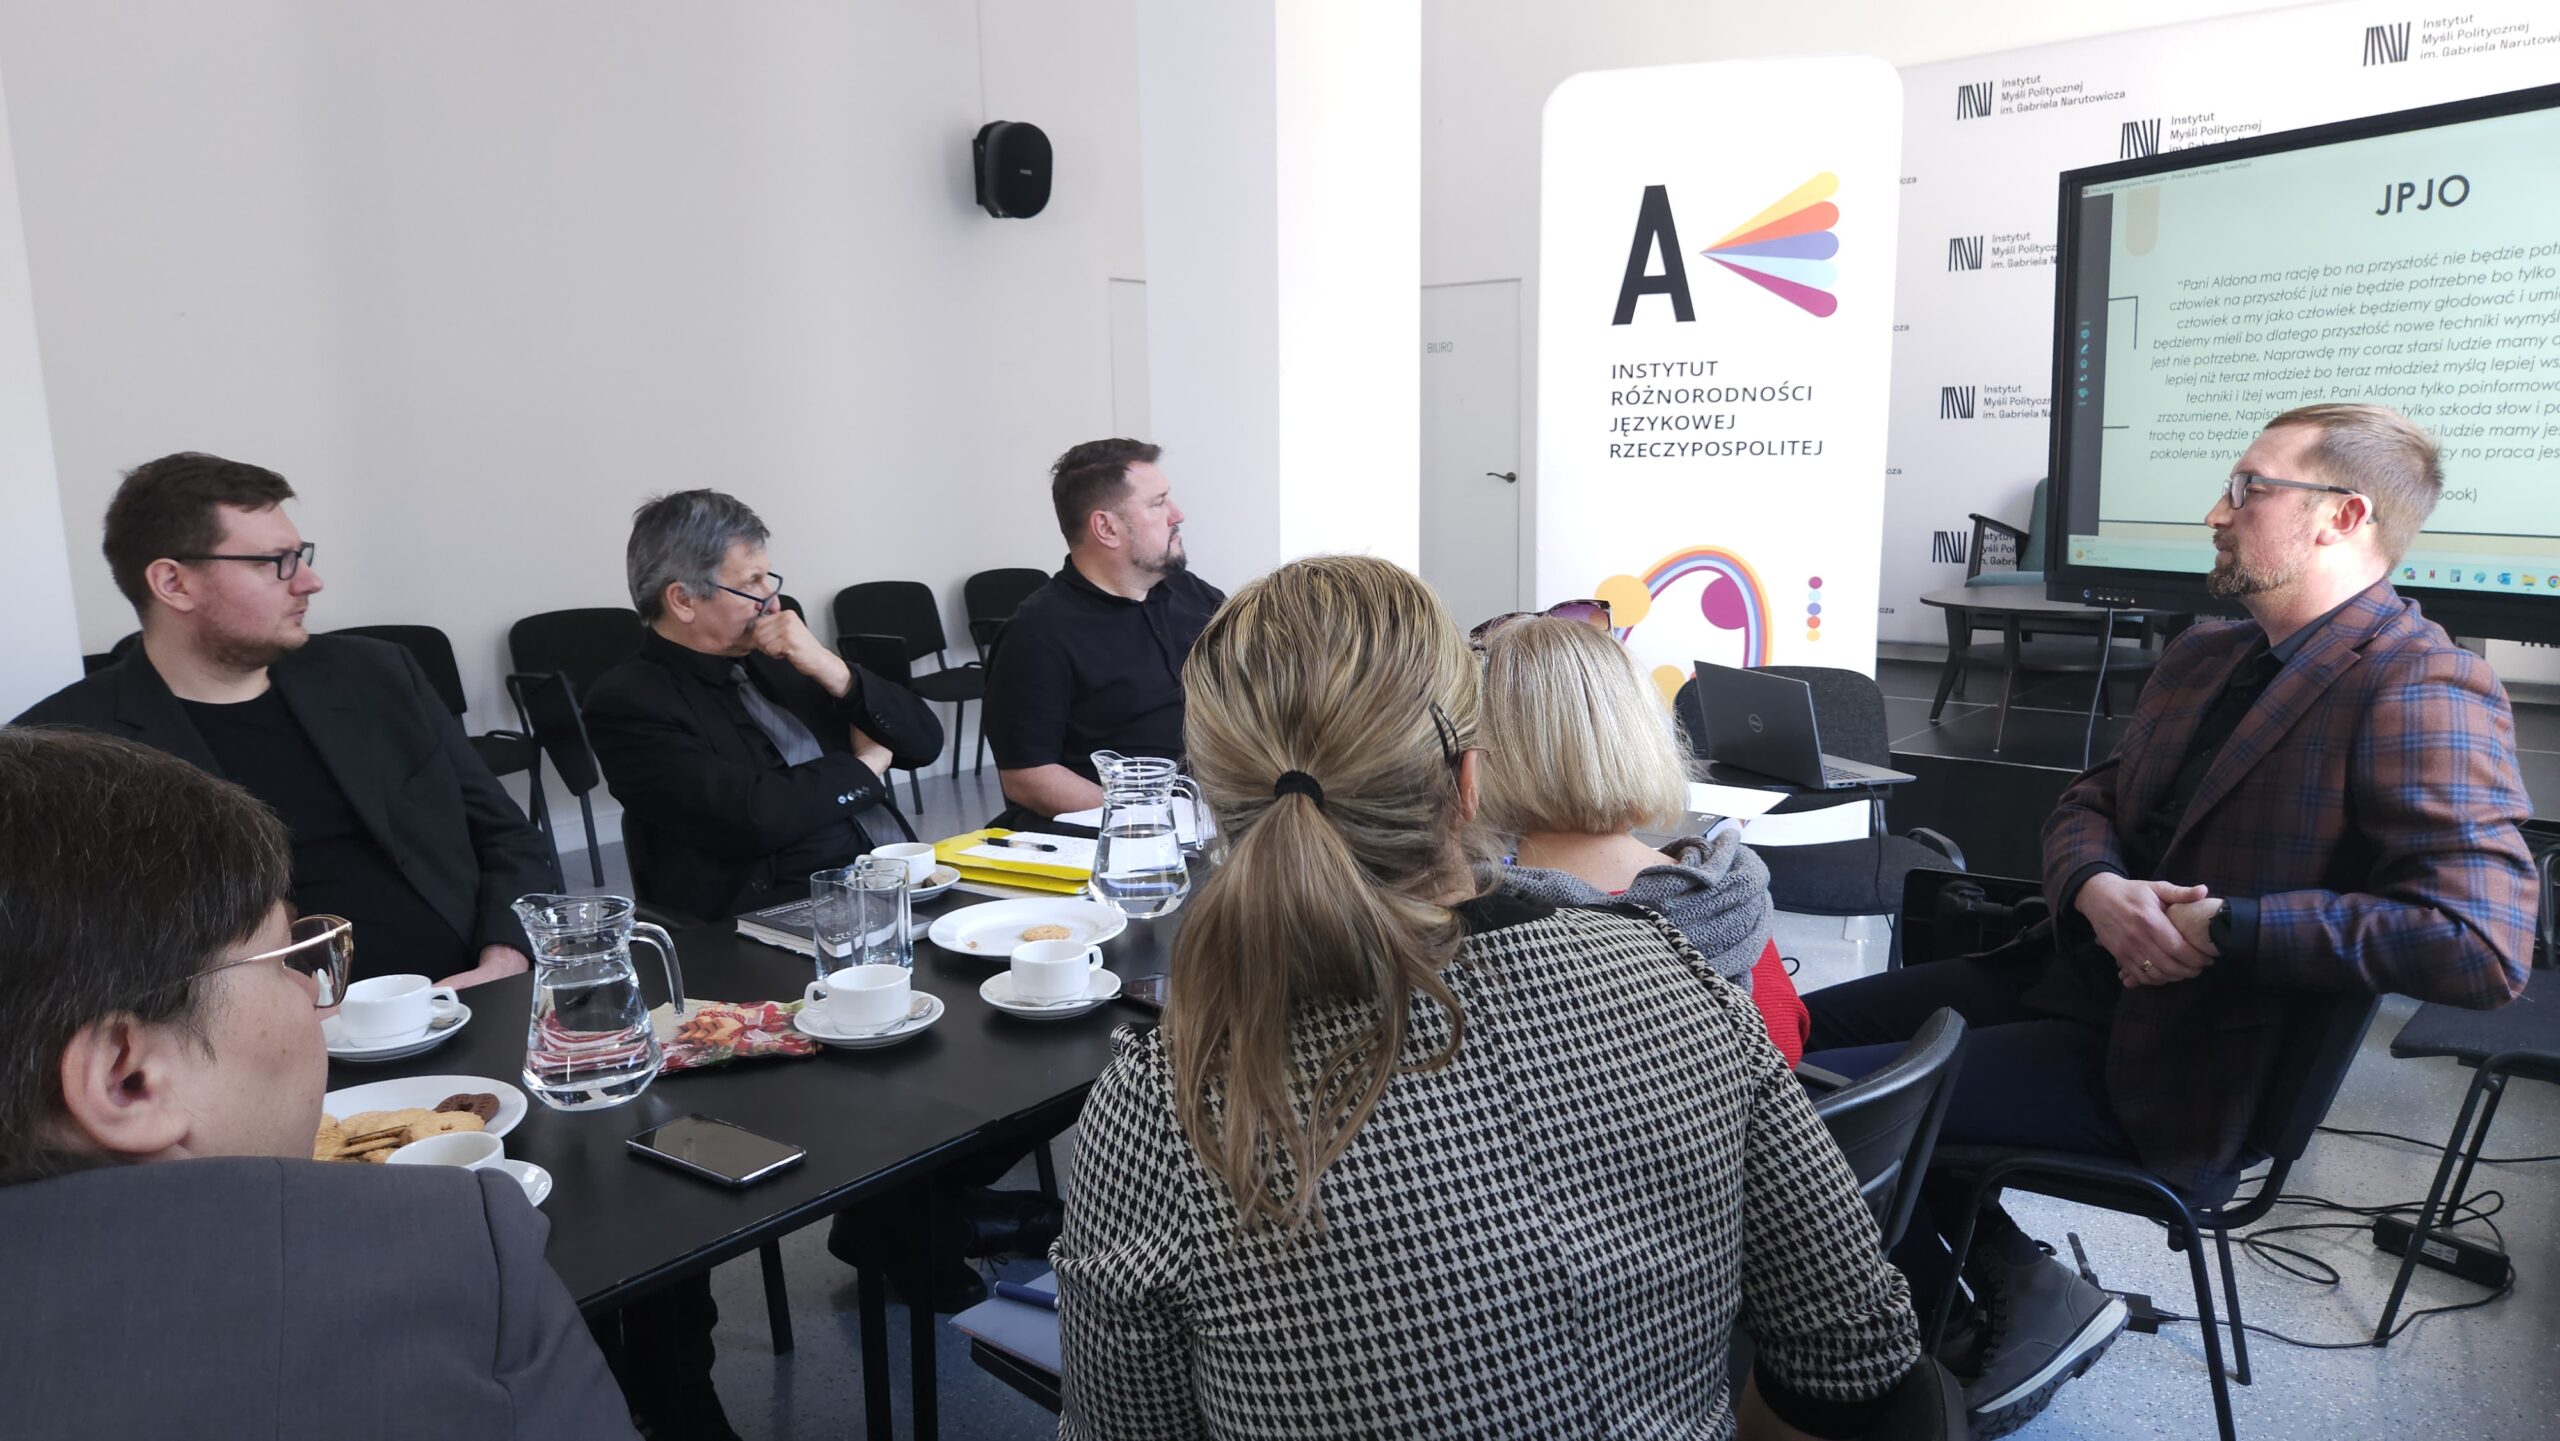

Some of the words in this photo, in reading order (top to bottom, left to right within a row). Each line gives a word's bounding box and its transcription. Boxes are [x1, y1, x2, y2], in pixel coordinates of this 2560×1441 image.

[2423, 14, 2474, 29] Instytut
[2421, 32, 2453, 47] Myśli
[2457, 21, 2530, 40] Politycznej
[2420, 50, 2439, 60] im.
[2442, 42, 2496, 58] Gabriela
[2500, 32, 2560, 49] Narutowi
[2002, 75, 2041, 88] Instytut
[2028, 80, 2083, 98] Politycznej
[2017, 99, 2058, 113] Gabriela
[2060, 90, 2126, 107] Narutowicza
[2171, 112, 2215, 126] Instytut
[2200, 120, 2262, 137] Politycznej
[2375, 174, 2470, 216] JPJO
[1992, 231, 2031, 243] Instytut
[2018, 241, 2057, 254] Politycz
[2007, 257, 2048, 268] Gabriela
[2211, 274, 2256, 288] Aldona
[2260, 271, 2281, 283] ma
[2285, 266, 2319, 282] rację
[2323, 263, 2341, 277] bo
[2345, 263, 2363, 275] na
[2367, 252, 2439, 274] przyszłość
[2442, 250, 2466, 265] nie
[2470, 245, 2524, 263] będzie
[2169, 295, 2220, 311] człowiek
[2224, 295, 2240, 307] na
[2243, 287, 2306, 306] przyszłość
[2309, 285, 2328, 300] już
[2331, 282, 2352, 297] nie
[2356, 278, 2405, 296] będzie
[2408, 273, 2487, 293] potrzebne
[2491, 269, 2513, 283] bo
[2517, 265, 2556, 283] tylko
[2176, 313, 2228, 329] człowiek
[2231, 314, 2241, 325] a
[2243, 312, 2263, 326] my
[2265, 308, 2294, 325] jako
[2297, 303, 2356, 320] człowiek
[2360, 298, 2431, 317] będziemy
[2435, 291, 2515, 312] głodować
[2519, 289, 2525, 302] i
[2153, 334, 2210, 351] będziemy
[2213, 330, 2243, 345] mieli
[2245, 330, 2263, 343] bo
[2266, 326, 2318, 345] dlatego
[2321, 320, 2390, 341] przyszłość
[2393, 319, 2435, 333] nowe
[2439, 313, 2499, 331] techniki
[1427, 341, 1453, 354] BIURO
[2150, 355, 2170, 371] jest
[2172, 353, 2191, 367] nie
[2193, 351, 2260, 368] potrzebne.
[2263, 347, 2335, 363] Naprawdę
[2338, 345, 2360, 359] my
[2363, 343, 2403, 356] coraz
[2406, 338, 2443, 354] starsi
[2446, 336, 2492, 351] ludzie
[2496, 336, 2548, 351] mamy
[1611, 361, 1719, 379] INSTYTUT
[2165, 373, 2197, 388] lepiej
[2200, 371, 2216, 384] niż
[2219, 369, 2250, 382] teraz
[2252, 366, 2311, 381] młodzież
[2313, 365, 2333, 378] bo
[2336, 363, 2371, 377] teraz
[2374, 361, 2440, 375] młodzież
[2443, 358, 2487, 374] myślą
[2490, 355, 2536, 373] lepiej
[1611, 380, 1812, 406] RÓŻNORODNOŚCI
[1984, 385, 2022, 396] Instytut
[2186, 389, 2233, 404] techniki
[2235, 389, 2240, 401] i
[2242, 388, 2263, 403] lżej
[2266, 390, 2297, 401] wam
[2299, 387, 2326, 402] jest.
[2330, 385, 2361, 399] Pani
[2363, 384, 2416, 398] Aldona
[2420, 382, 2455, 398] tylko
[1999, 409, 2039, 419] Gabriela
[2157, 409, 2232, 423] zrzozumiene.
[2235, 407, 2284, 423] Napisa
[2402, 401, 2435, 417] tylko
[2439, 400, 2492, 416] szkoda
[2535, 399, 2541, 414] i
[1609, 414, 1736, 437] JĘZYKOWEJ
[2149, 427, 2186, 443] trochę
[2189, 430, 2204, 441] co
[2207, 427, 2249, 442] będzie
[2440, 424, 2485, 437] ludzie
[2488, 424, 2540, 439] mamy
[1609, 440, 1823, 458] RZECZYPOSPOLITEJ
[2150, 446, 2207, 461] pokolenie
[2484, 447, 2535, 461] praca
[2537, 444, 2560, 461] jes
